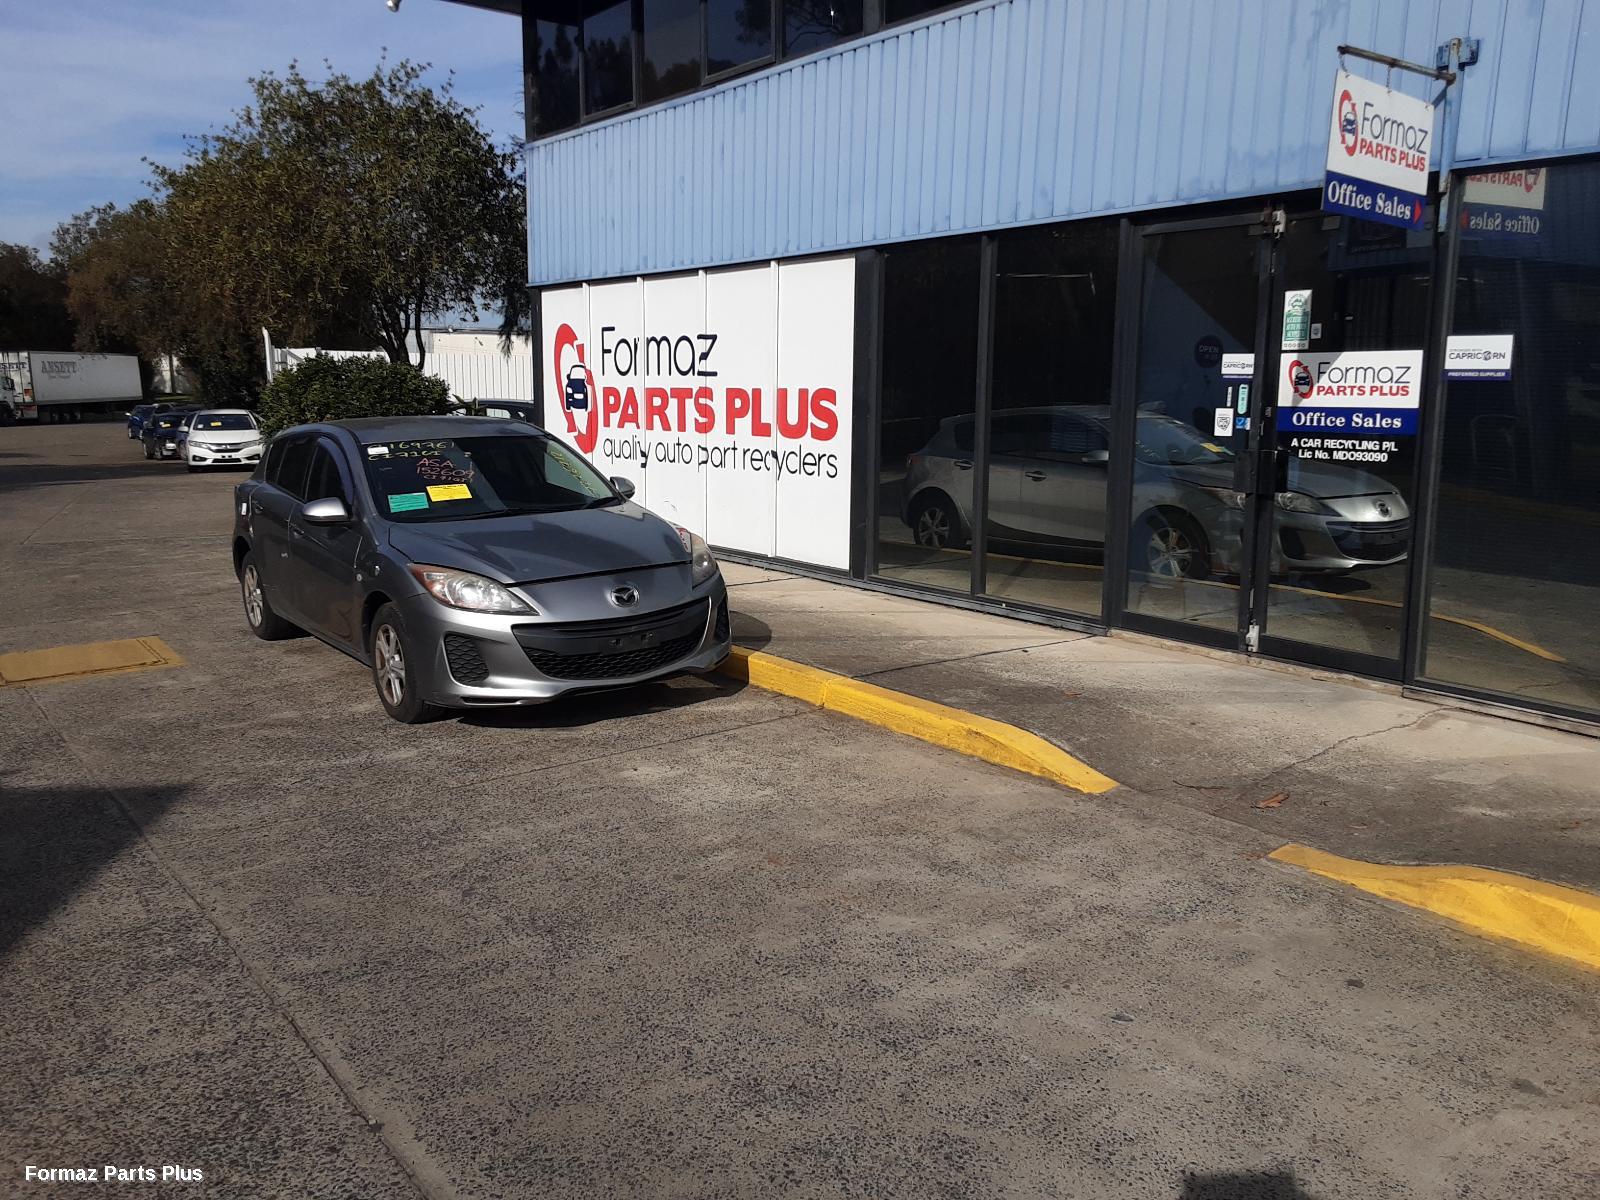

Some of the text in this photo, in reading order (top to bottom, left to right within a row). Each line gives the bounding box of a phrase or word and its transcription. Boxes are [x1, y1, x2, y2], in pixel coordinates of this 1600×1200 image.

[1361, 101, 1428, 155] Formaz
[1359, 137, 1426, 172] PARTS PLUS
[1327, 180, 1412, 220] Office Sales
[601, 326, 718, 377] Formaz
[1316, 361, 1411, 384] Formaz
[1316, 385, 1410, 397] PARTS PLUS
[602, 387, 839, 442] PARTS PLUS
[1292, 411, 1402, 429] Office Sales
[655, 437, 693, 465] auto
[697, 441, 738, 472] part
[742, 444, 838, 481] recyclers
[1291, 438, 1398, 452] A CAR RECYCLING P/L
[1298, 449, 1312, 458] Lic
[1314, 450, 1331, 459] No.
